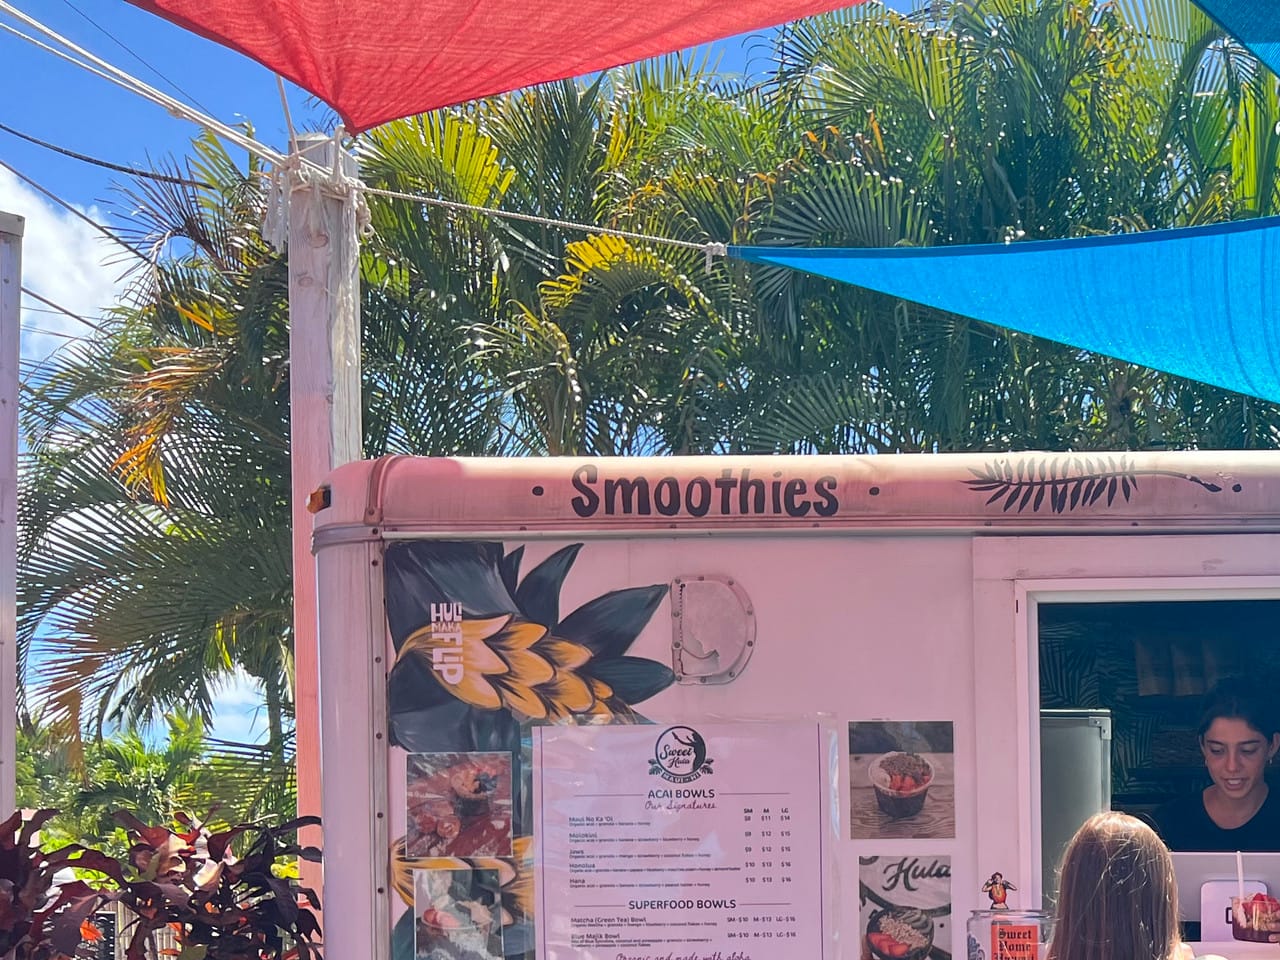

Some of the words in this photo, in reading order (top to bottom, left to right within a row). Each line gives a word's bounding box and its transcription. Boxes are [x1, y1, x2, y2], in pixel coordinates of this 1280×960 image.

[570, 463, 839, 518] Smoothies
[660, 744, 692, 760] Sweet
[667, 757, 690, 768] Hula
[648, 789, 673, 799] ACAI
[675, 788, 715, 798] BOWLS
[645, 800, 661, 810] Our
[666, 800, 717, 813] Signatures
[629, 900, 694, 910] SUPERFOOD
[697, 899, 736, 909] BOWLS
[999, 928, 1032, 939] Sweet
[702, 952, 723, 960] with
